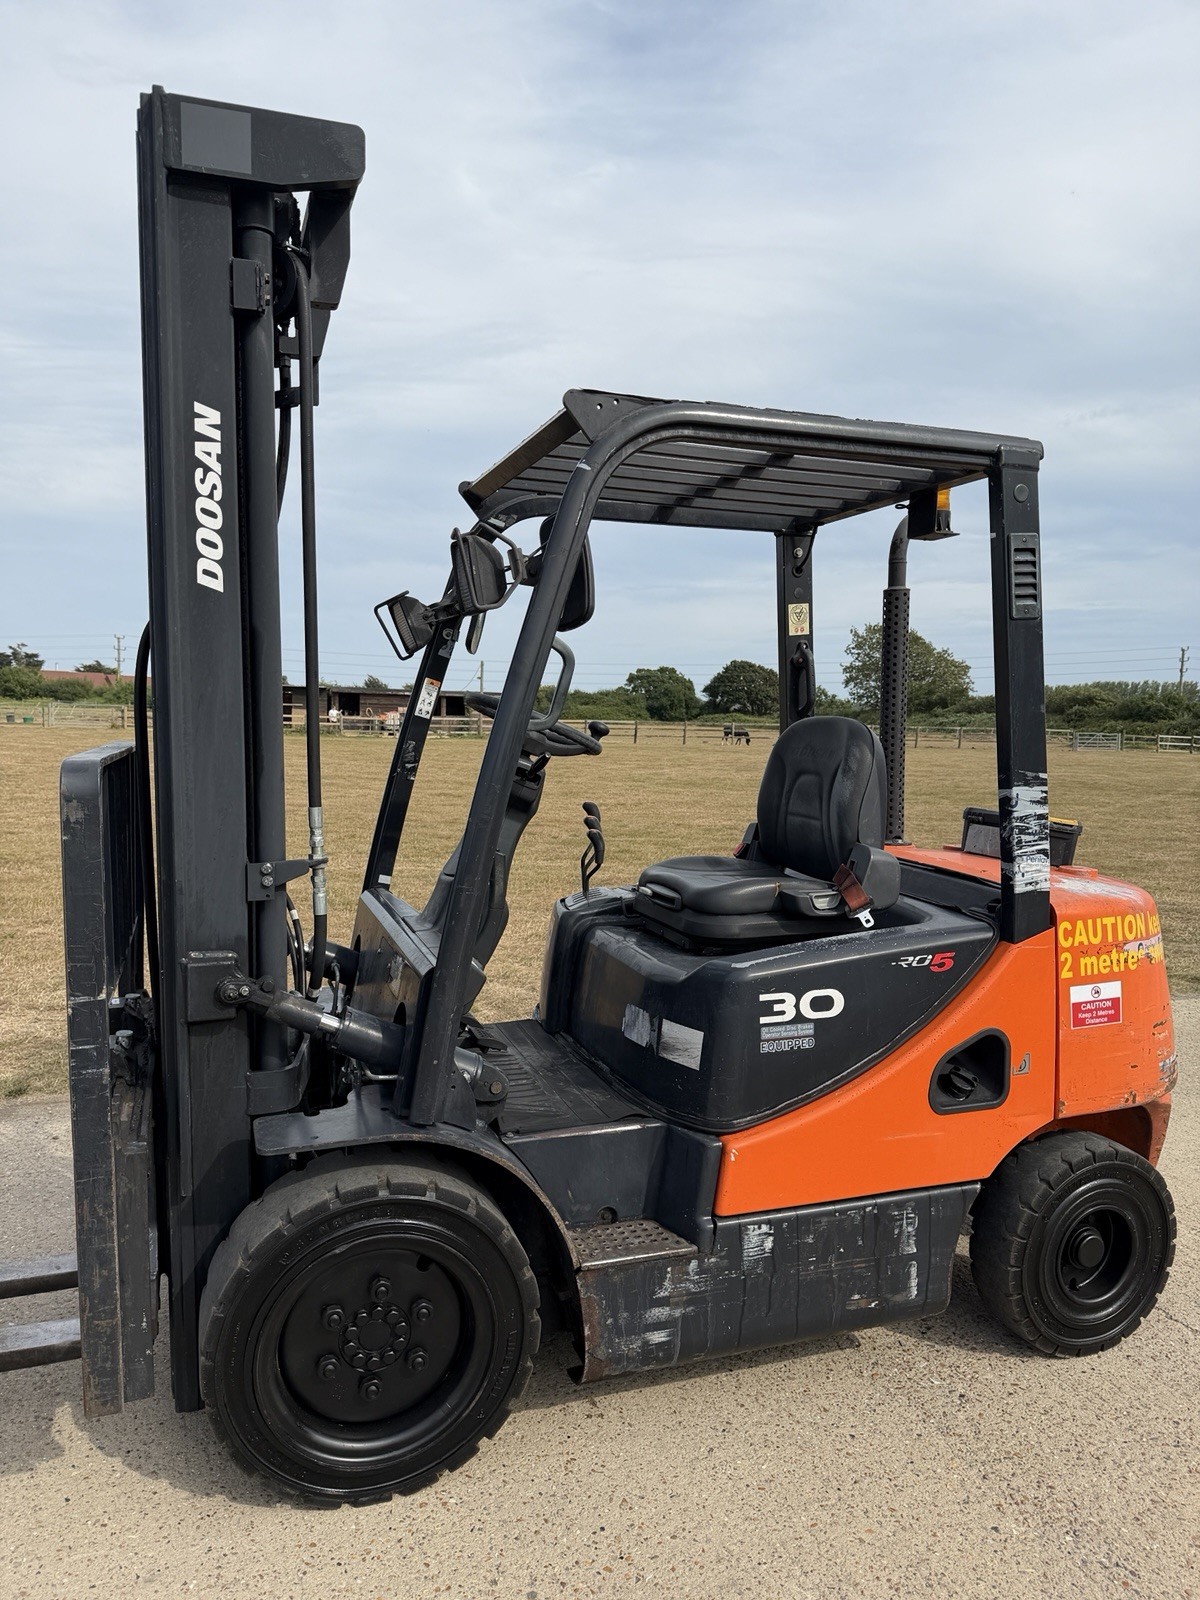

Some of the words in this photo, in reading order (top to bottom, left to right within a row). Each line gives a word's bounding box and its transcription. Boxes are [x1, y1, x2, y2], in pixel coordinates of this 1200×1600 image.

[194, 401, 224, 592] DOOSAN
[1058, 914, 1145, 948] CAUTION
[1060, 952, 1074, 979] 2
[760, 988, 844, 1024] 30
[1081, 1000, 1111, 1010] CAUTION
[760, 1037, 815, 1053] EQUIPPED
